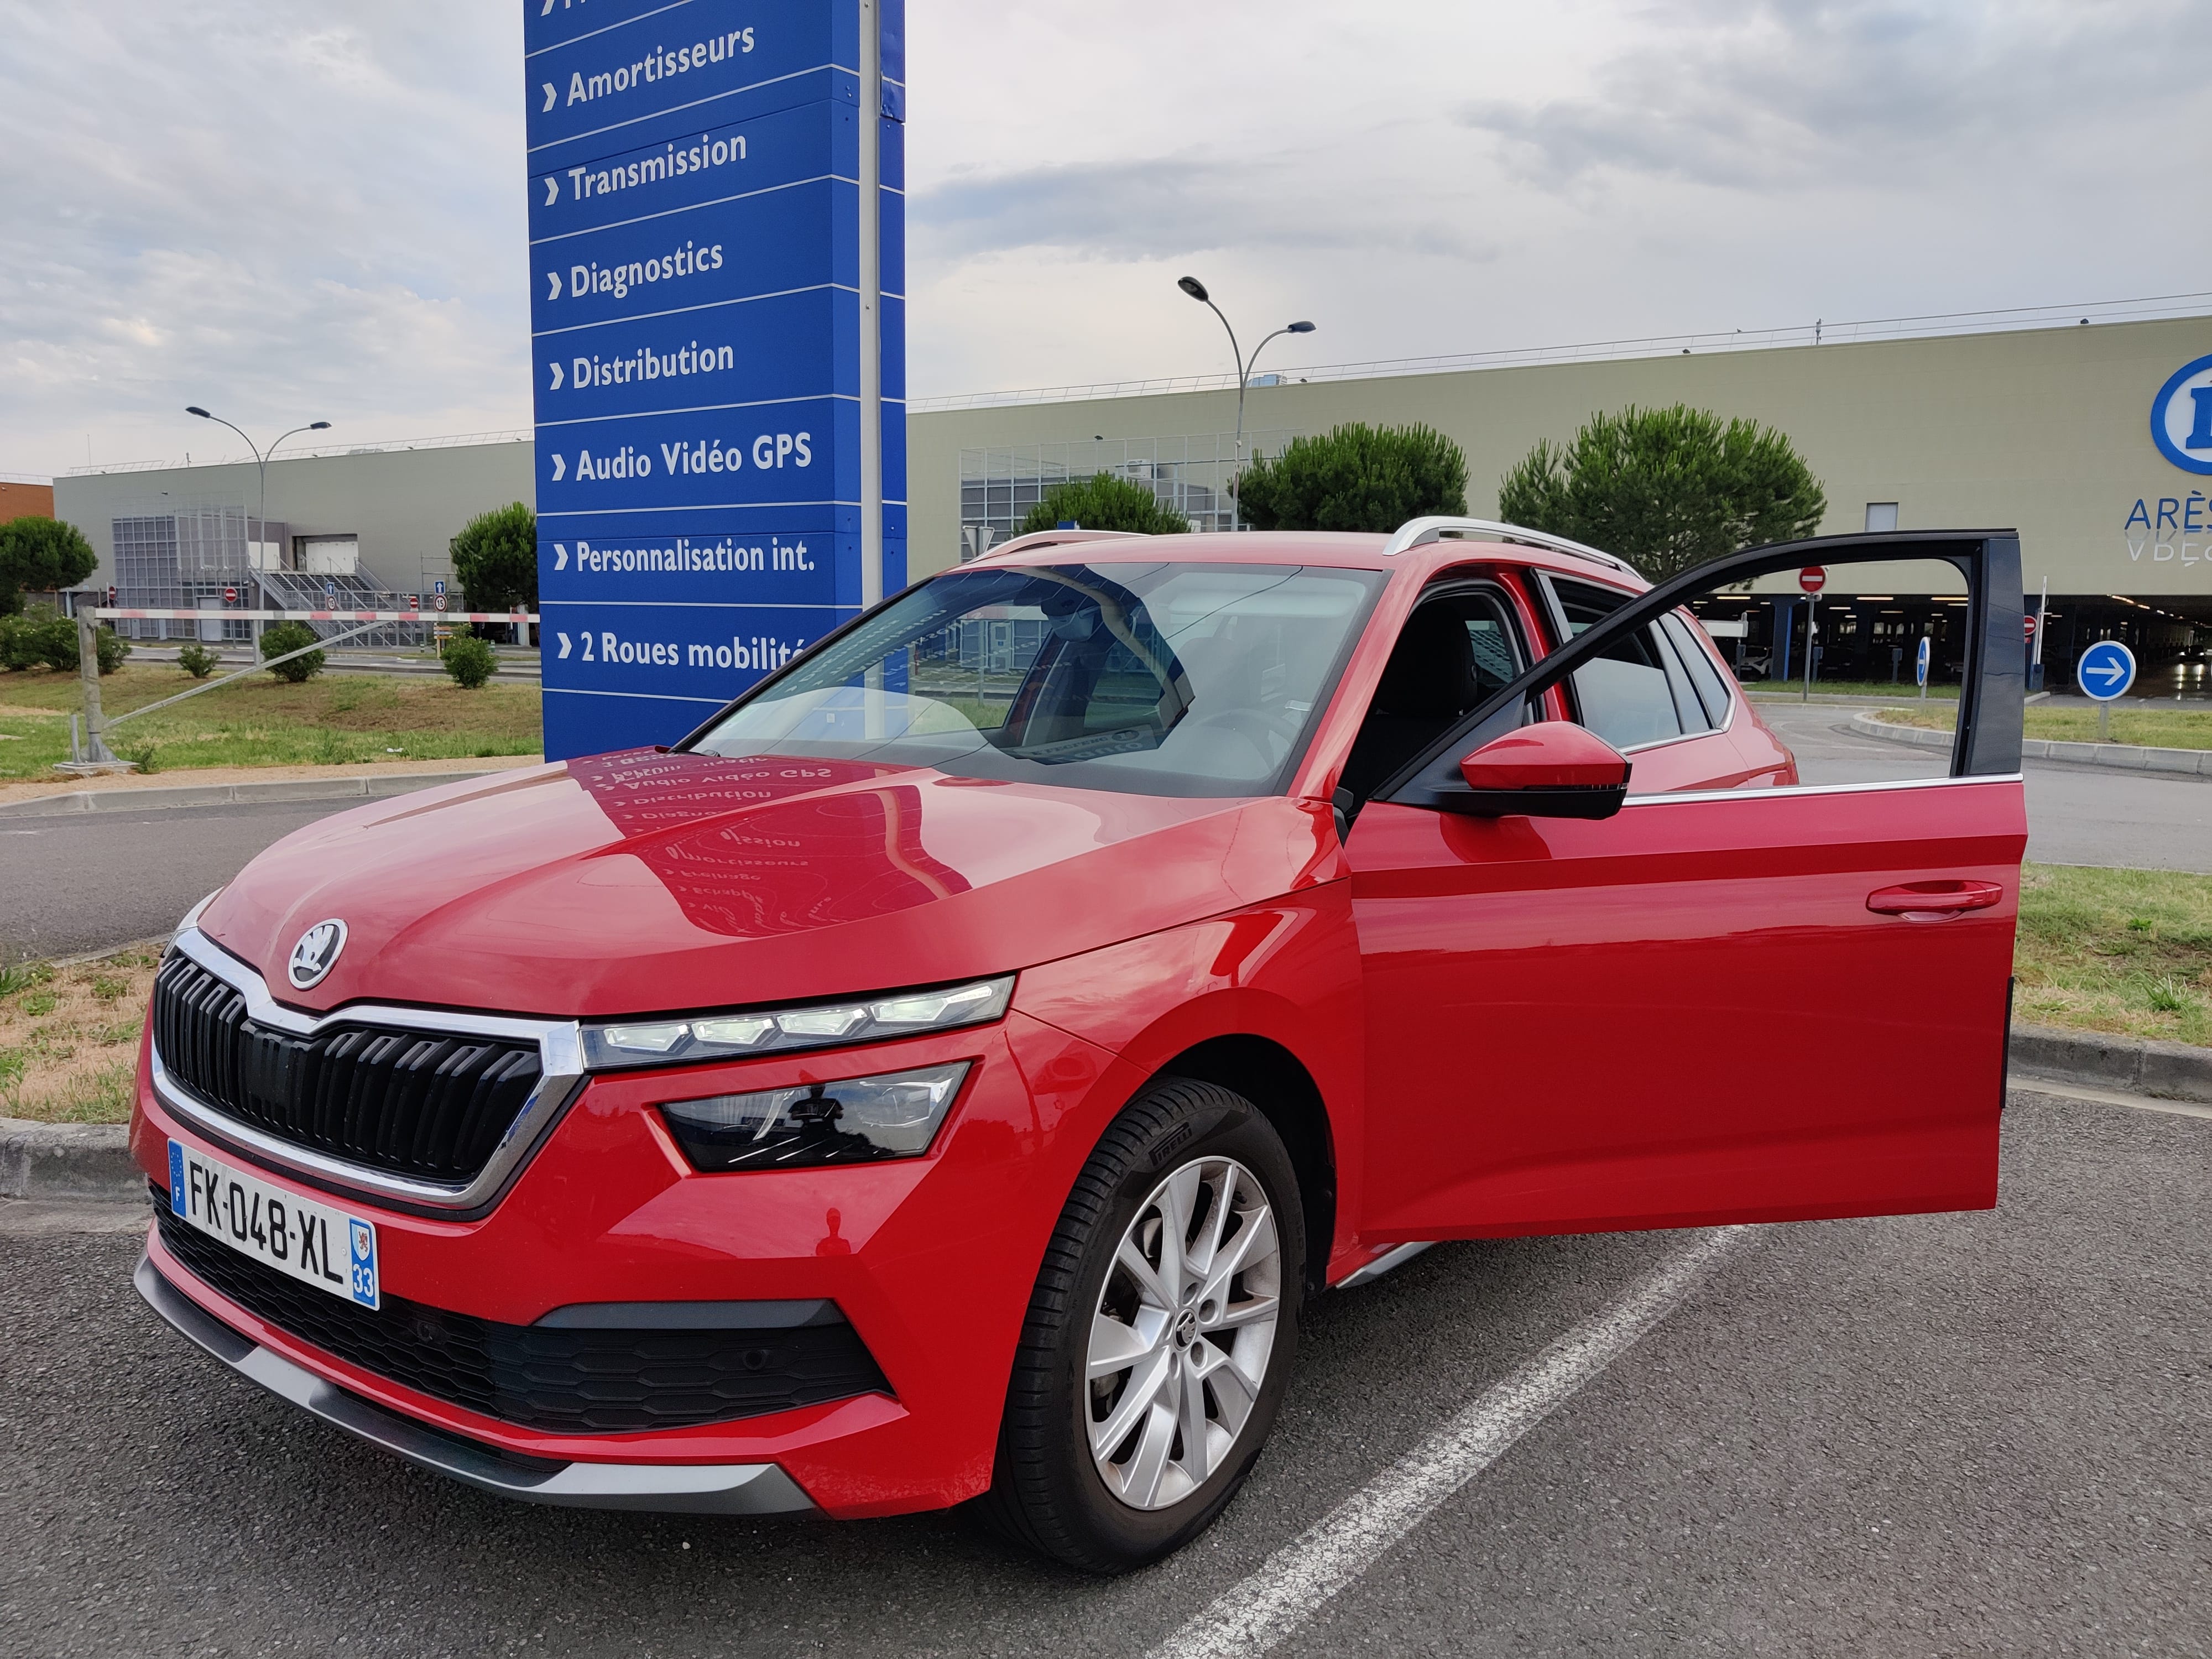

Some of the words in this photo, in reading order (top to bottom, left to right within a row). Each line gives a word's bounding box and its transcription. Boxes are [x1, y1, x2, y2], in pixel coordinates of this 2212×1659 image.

[567, 27, 755, 107] Amortisseurs
[568, 134, 747, 201] Transmission
[571, 240, 723, 299] Diagnostics
[573, 340, 733, 389] Distribution
[576, 446, 651, 481] Audio
[660, 439, 742, 476] Vidéo
[753, 432, 811, 469] GPS
[2124, 490, 2212, 531] ARÈ
[577, 538, 764, 572] Personnalisation
[772, 537, 815, 571] int.
[437, 599, 445, 608] 15
[581, 632, 594, 661] 2
[602, 632, 679, 666] Roues
[1148, 1121, 1193, 1167] PIRELLI
[174, 1186, 181, 1202] F
[189, 1160, 344, 1285] FK-048-XL
[352, 1263, 375, 1298] 33
